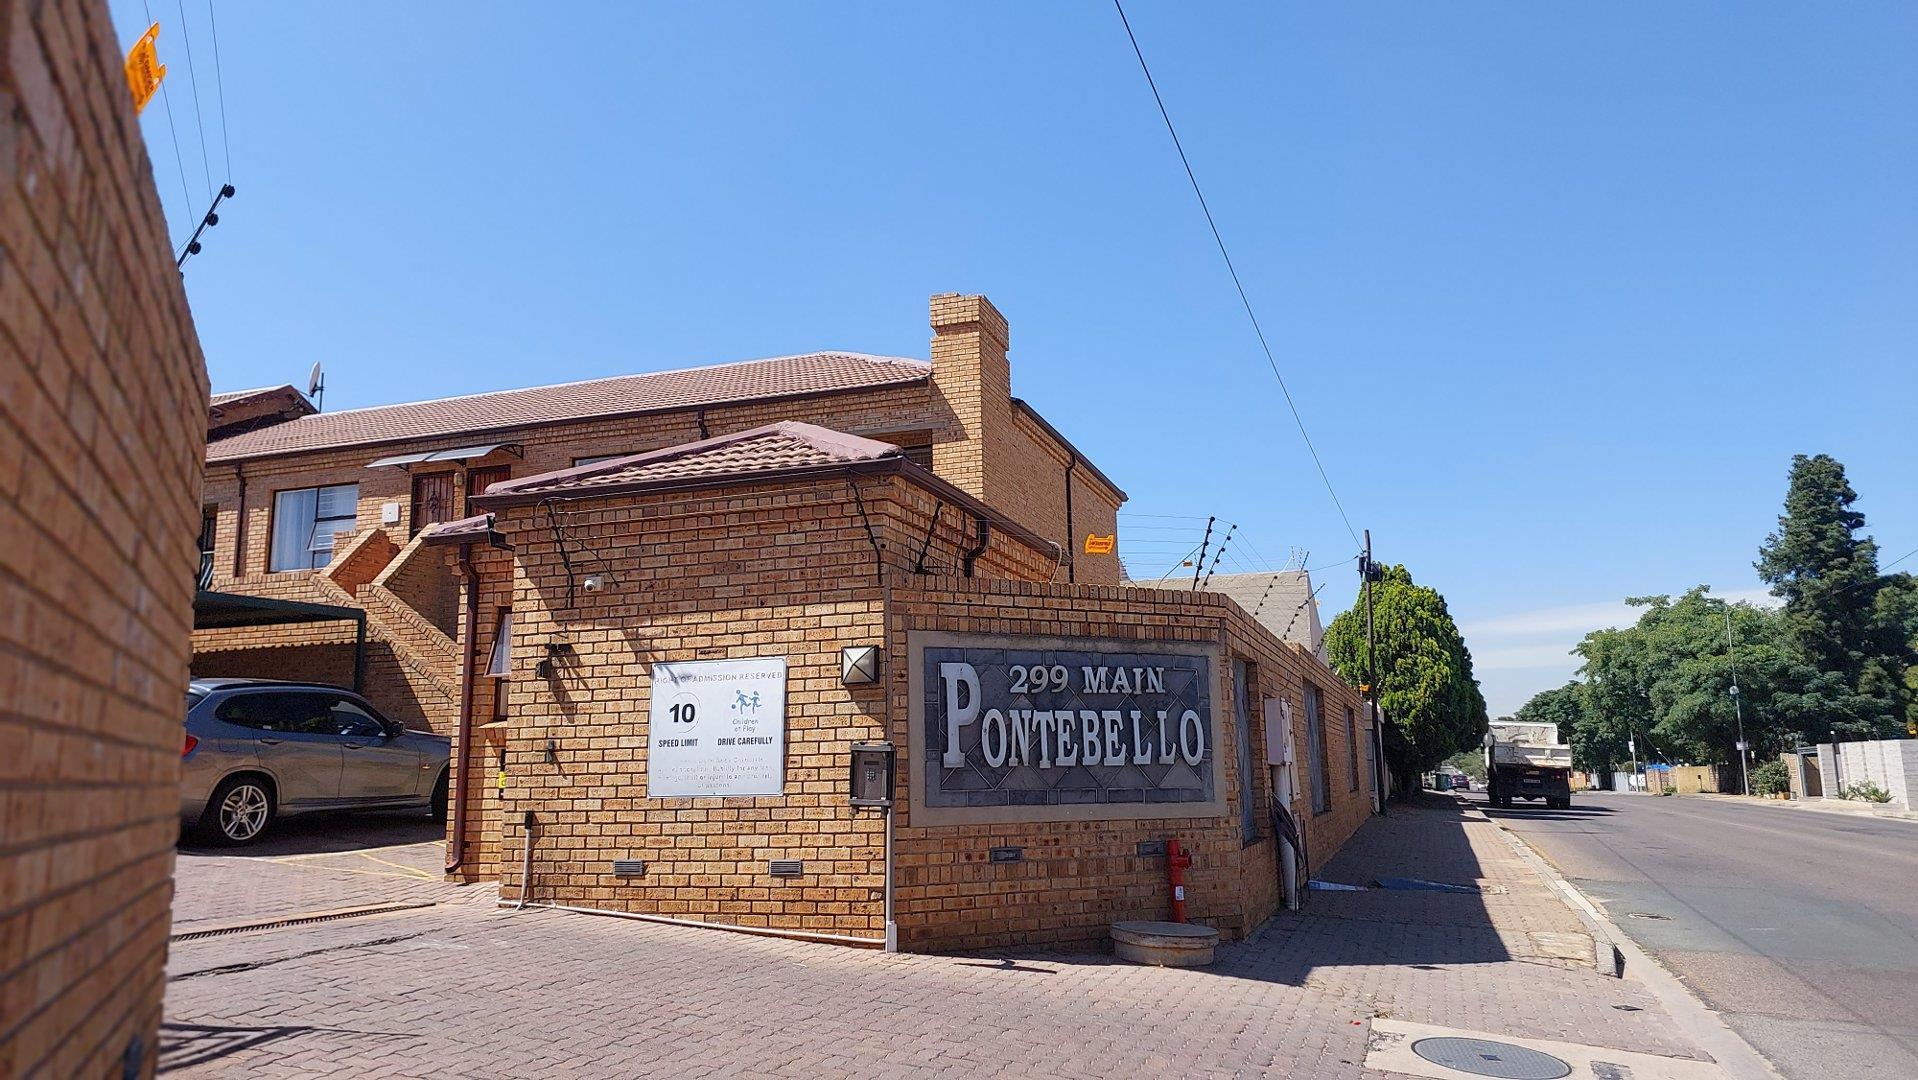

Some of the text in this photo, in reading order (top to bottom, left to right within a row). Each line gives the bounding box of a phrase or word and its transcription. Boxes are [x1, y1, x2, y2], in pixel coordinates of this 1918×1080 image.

[692, 673, 738, 683] ADMISSION
[739, 671, 783, 681] RESERVED
[1008, 664, 1167, 696] 299 MAIN
[669, 703, 696, 723] 10
[939, 661, 1205, 770] PONTEBELLO
[732, 717, 759, 725] Children
[742, 724, 756, 733] Play
[658, 738, 699, 748] SPEED LIMIT
[717, 736, 773, 746] DRIVE CAREFULLY
